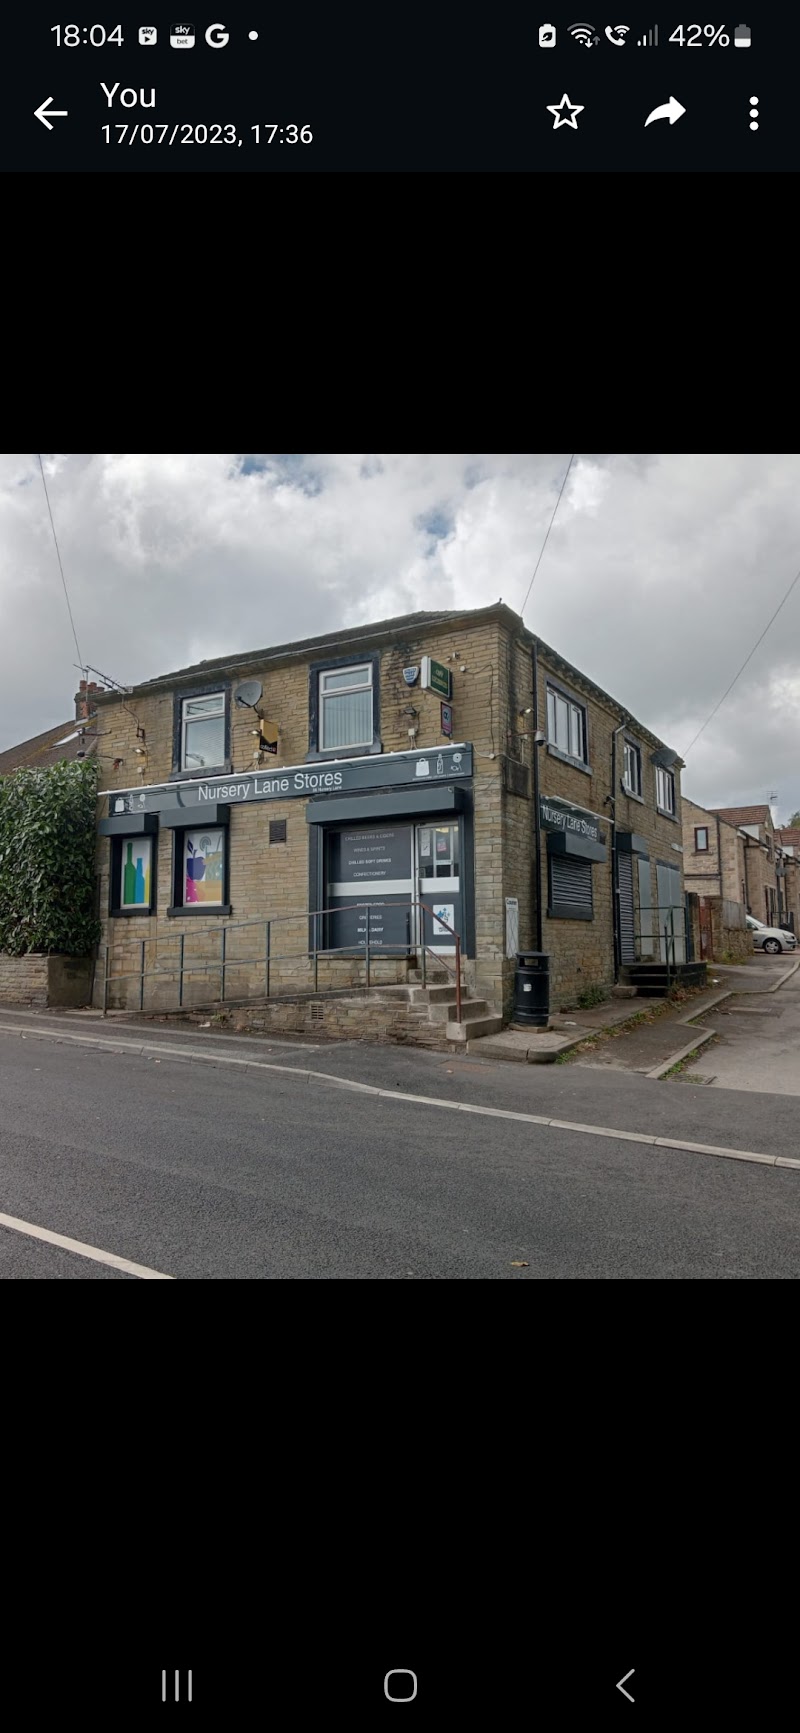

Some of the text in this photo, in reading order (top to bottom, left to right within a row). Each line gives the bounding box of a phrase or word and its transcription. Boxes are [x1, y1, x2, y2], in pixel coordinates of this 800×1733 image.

[198, 772, 343, 801] Nursery Lane Stores
[542, 806, 598, 838] Nursery Lane Stores
